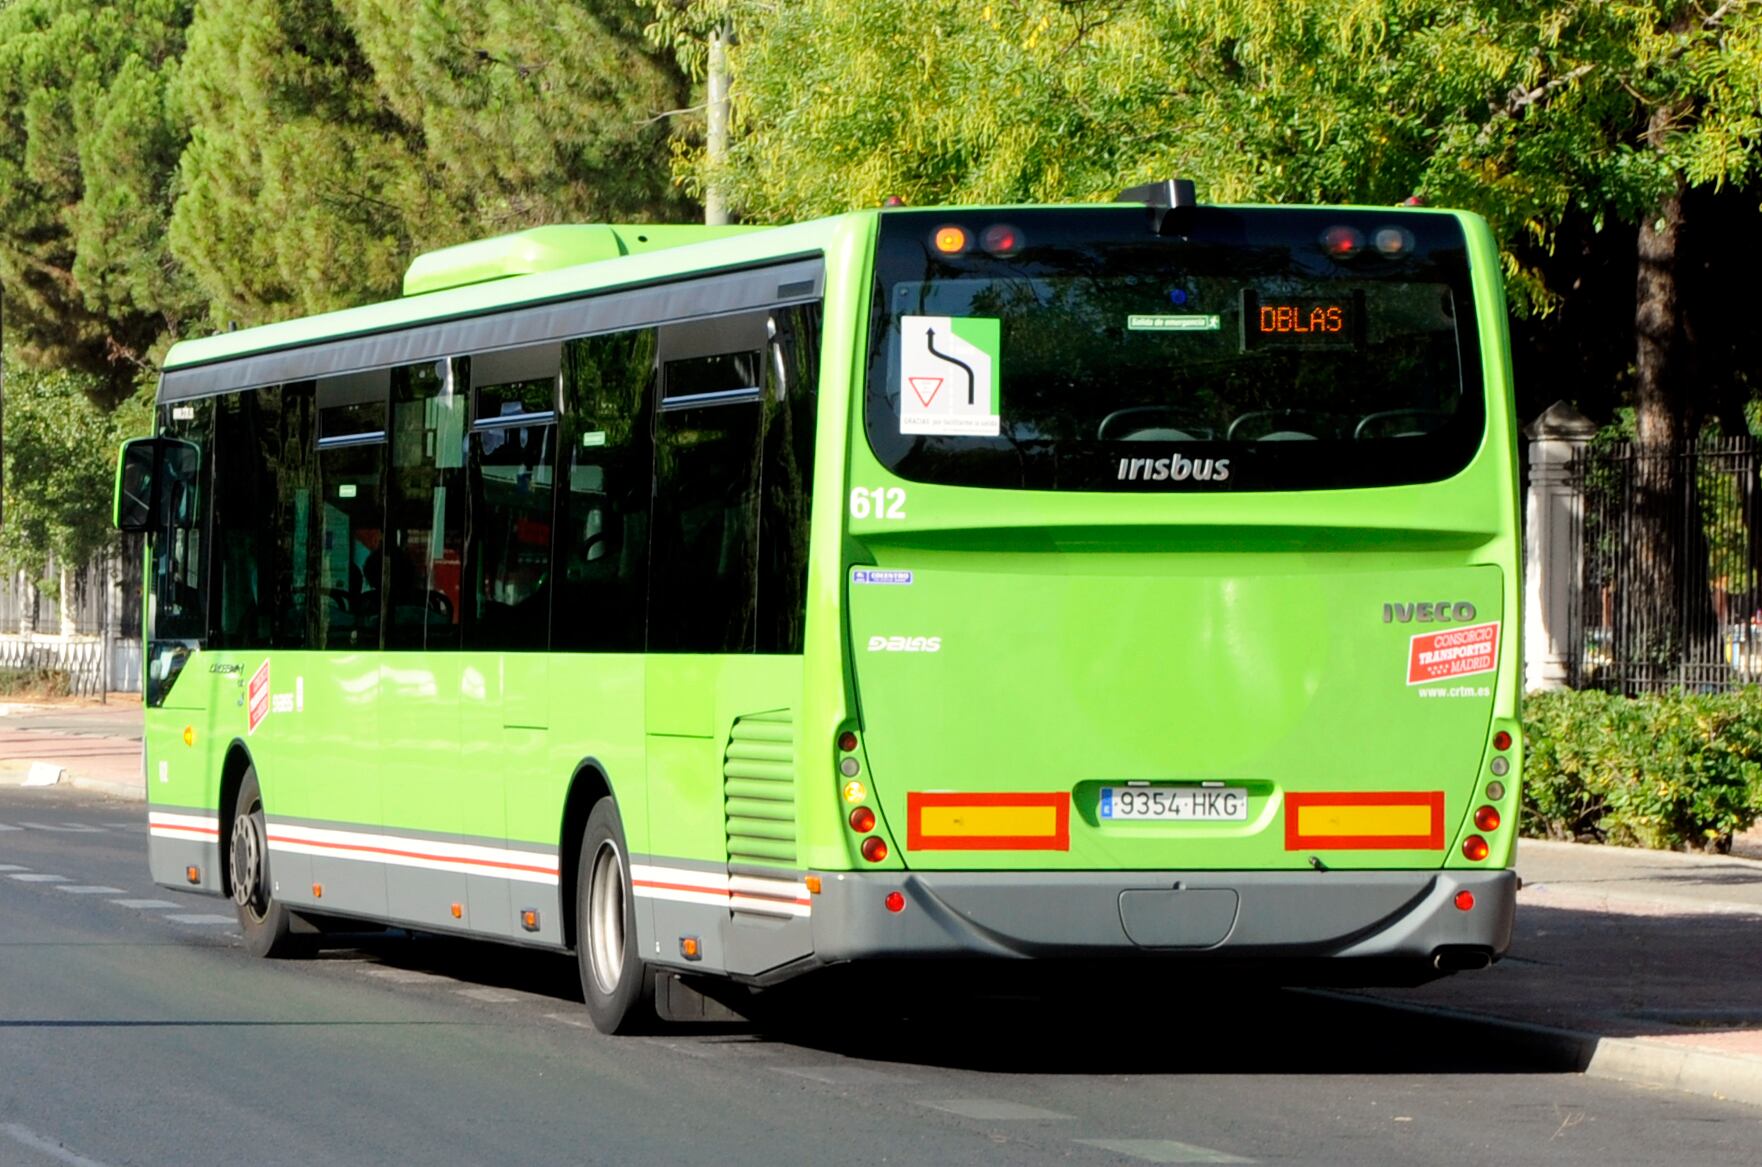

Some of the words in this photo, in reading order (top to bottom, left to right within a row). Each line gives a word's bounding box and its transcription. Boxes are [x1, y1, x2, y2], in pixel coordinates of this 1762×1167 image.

[1260, 306, 1342, 332] DBLAS
[1117, 453, 1230, 481] irisbus
[850, 487, 906, 520] 612
[1383, 601, 1477, 624] IVECO
[1434, 628, 1493, 648] CONSORCIO
[1418, 642, 1492, 666] TRANSPORTES
[1450, 656, 1491, 674] MADRID
[1418, 686, 1491, 698] www.crtm.es
[1121, 792, 1181, 816] 9354
[1193, 792, 1238, 816] HKG
